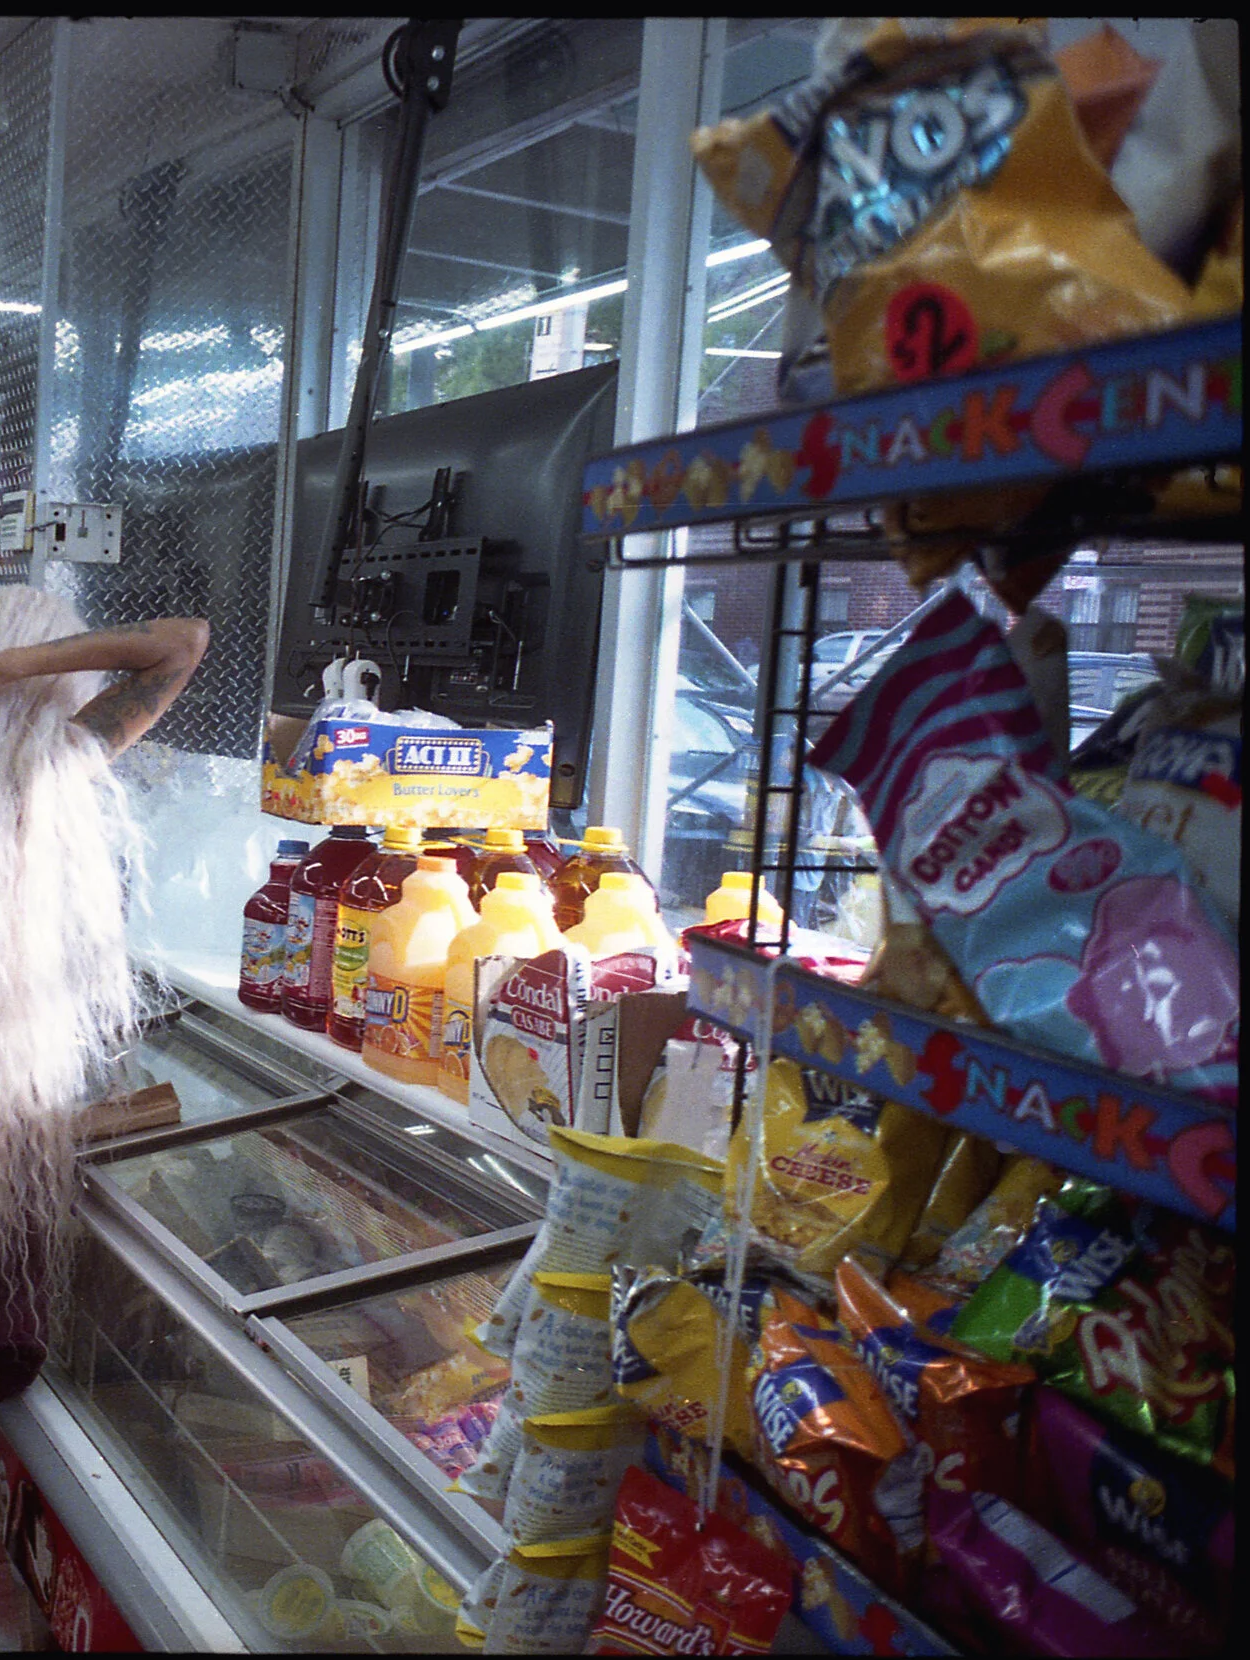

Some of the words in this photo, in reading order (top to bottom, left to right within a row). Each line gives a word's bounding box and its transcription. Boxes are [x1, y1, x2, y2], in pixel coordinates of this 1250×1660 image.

[797, 383, 1021, 499] SNACK
[393, 782, 435, 797] Butter
[403, 745, 447, 766] ACT
[447, 746, 473, 766] II
[910, 766, 1025, 886] COTTON
[506, 972, 565, 1020] Condal
[917, 1029, 1155, 1173] SNACK
[769, 1154, 874, 1196] CHEESE
[1048, 1227, 1138, 1300] WISE
[753, 1371, 796, 1455] WISE
[604, 1582, 716, 1658] Howard's
